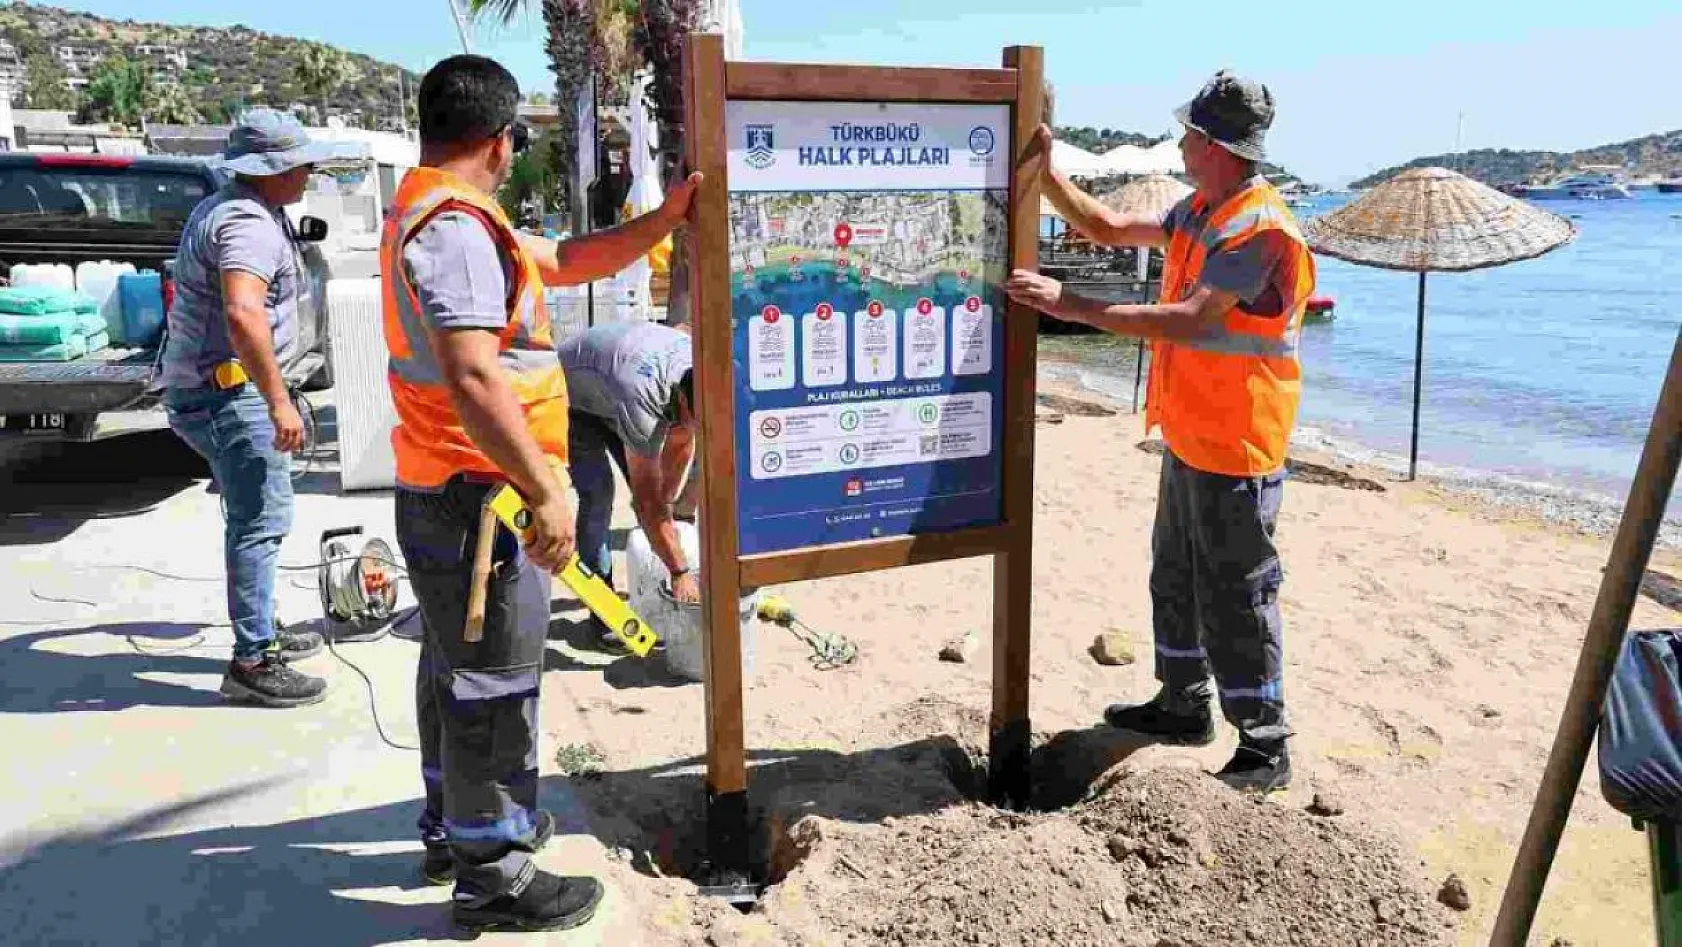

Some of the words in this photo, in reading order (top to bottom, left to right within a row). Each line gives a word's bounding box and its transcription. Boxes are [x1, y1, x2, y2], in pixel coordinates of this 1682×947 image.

[831, 123, 920, 142] TÜRKBÜKÜ
[798, 146, 852, 166] HALK
[857, 146, 950, 166] PLAJLARI
[807, 390, 828, 403] PLAJ
